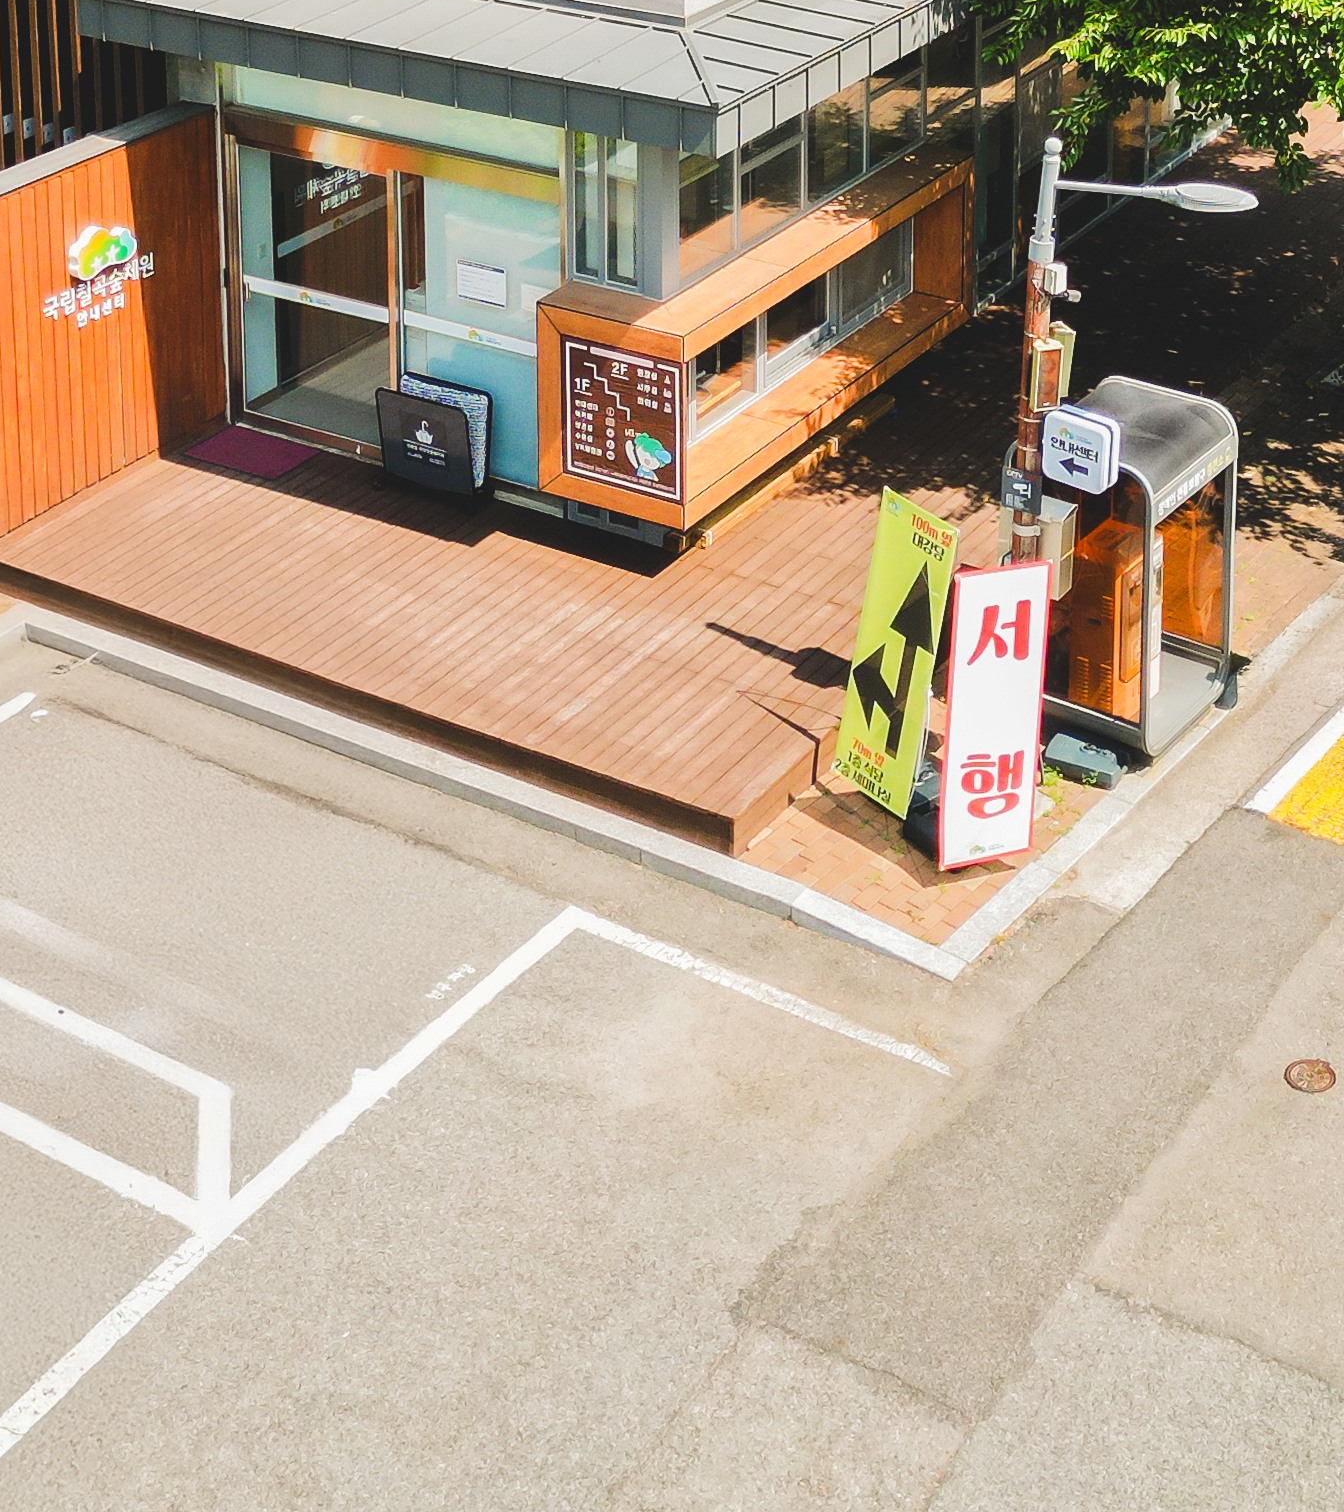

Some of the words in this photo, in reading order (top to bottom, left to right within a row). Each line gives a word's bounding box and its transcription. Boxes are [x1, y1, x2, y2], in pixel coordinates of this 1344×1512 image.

[42, 251, 155, 321] 국립칠곡숲체원
[77, 292, 125, 328] 안내센터
[611, 361, 629, 376] 2F
[574, 377, 591, 392] 1F
[1050, 436, 1099, 463] 안내센터
[911, 513, 939, 540] 100m
[912, 532, 945, 562] 대강당
